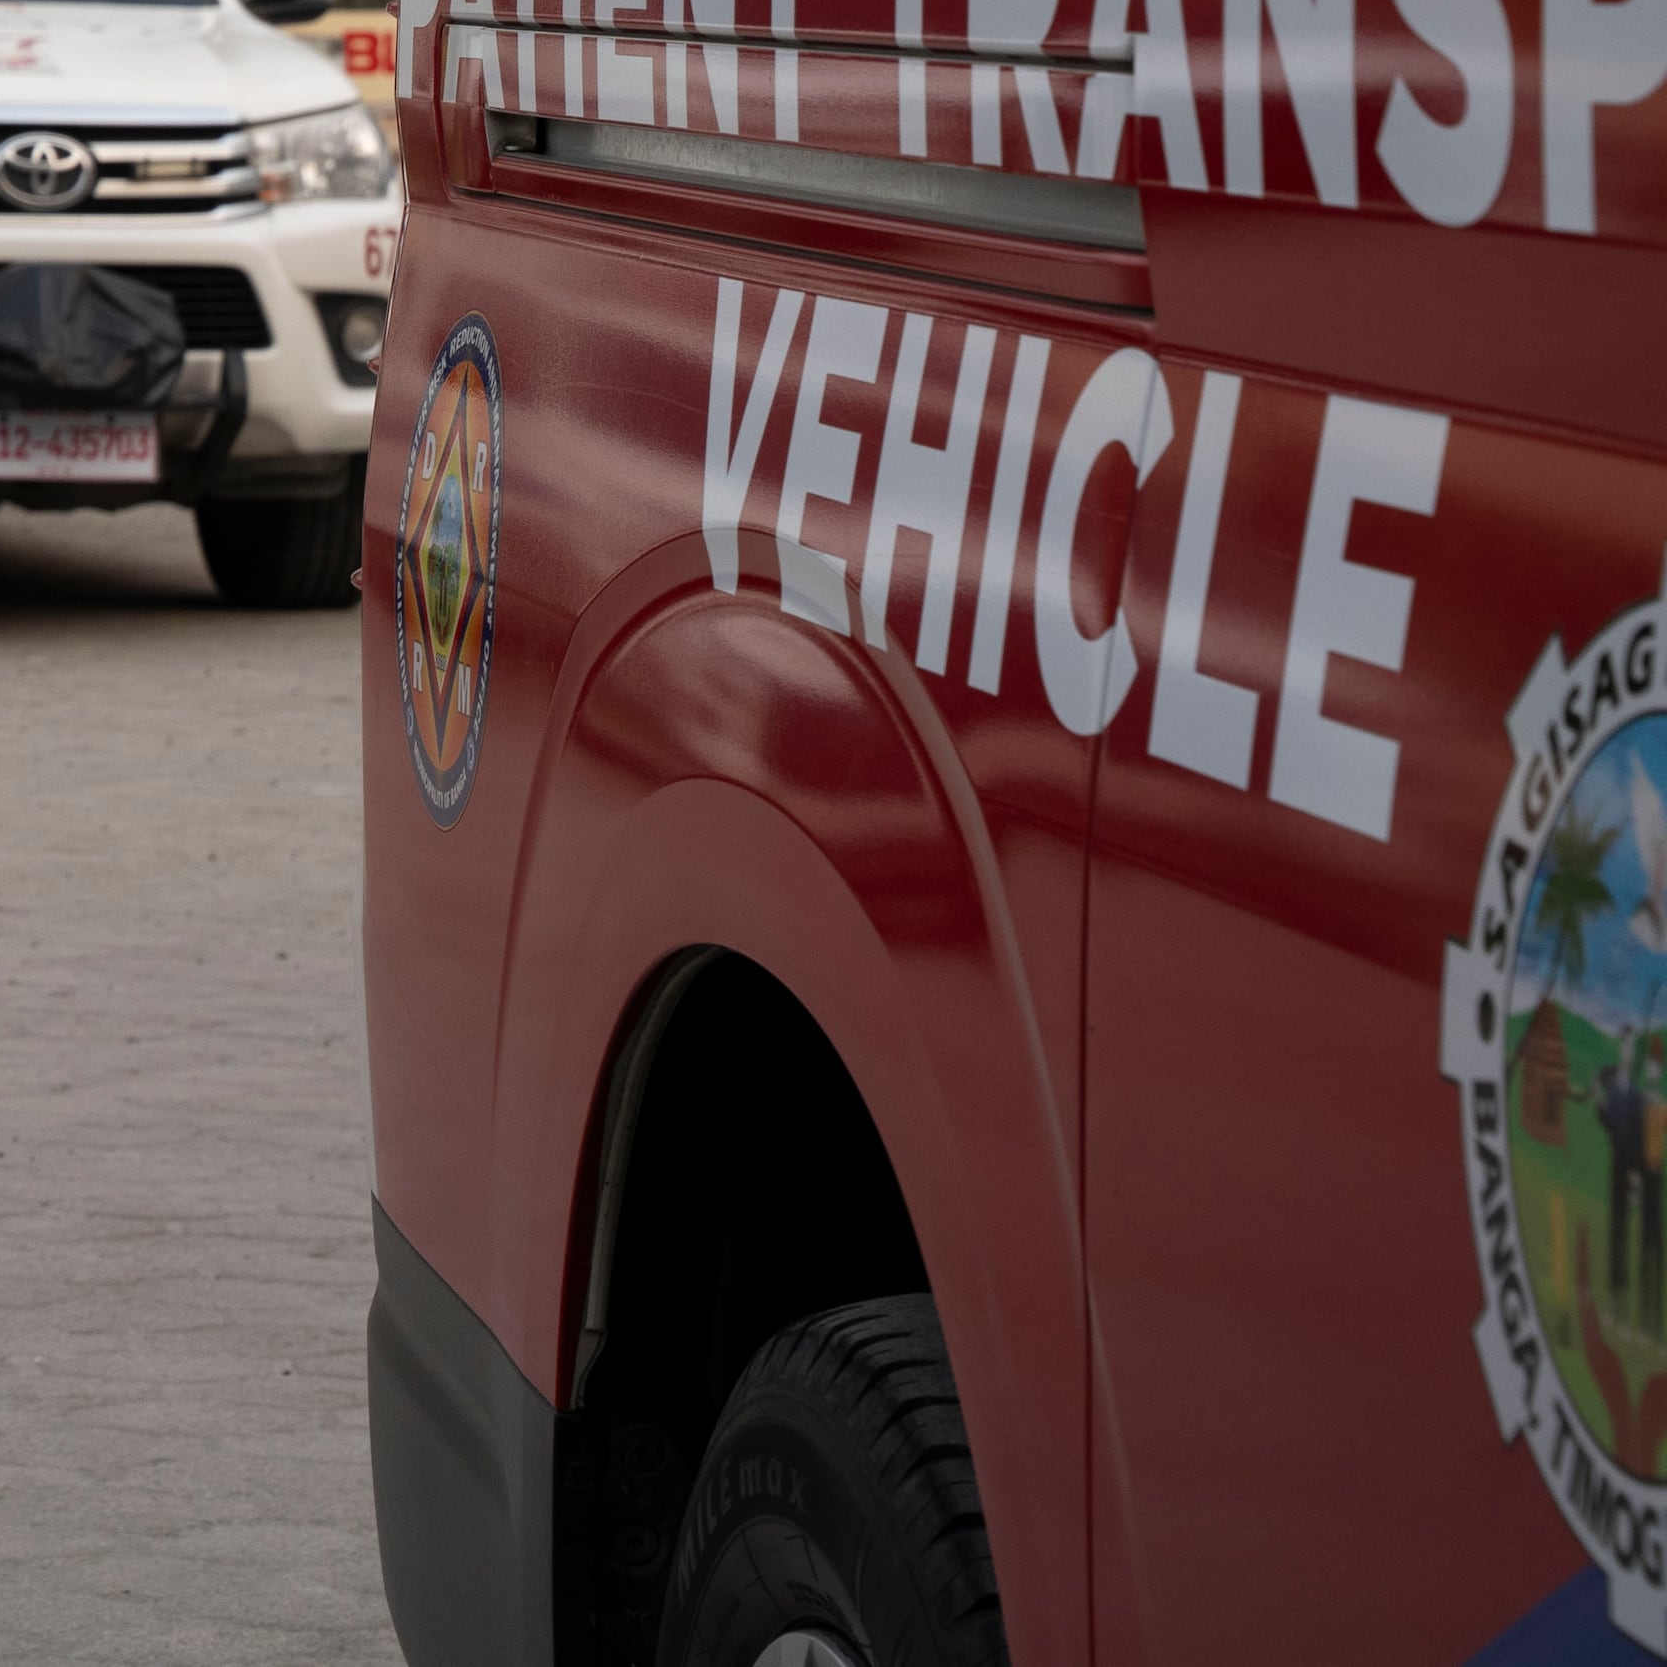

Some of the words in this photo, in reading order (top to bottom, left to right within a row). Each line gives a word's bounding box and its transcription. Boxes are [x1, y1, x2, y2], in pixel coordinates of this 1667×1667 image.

[428, 350, 448, 404] RISK
[449, 325, 491, 363] REDUCTION
[486, 355, 499, 402] AND
[421, 430, 437, 480] D
[473, 441, 487, 493] R
[702, 277, 1452, 844] VEHICLE
[412, 640, 424, 693] R
[457, 661, 472, 716] M
[473, 640, 490, 740] OFFICE
[1481, 622, 1657, 973] SAGISAG
[1473, 1080, 1542, 1430] BANGA,
